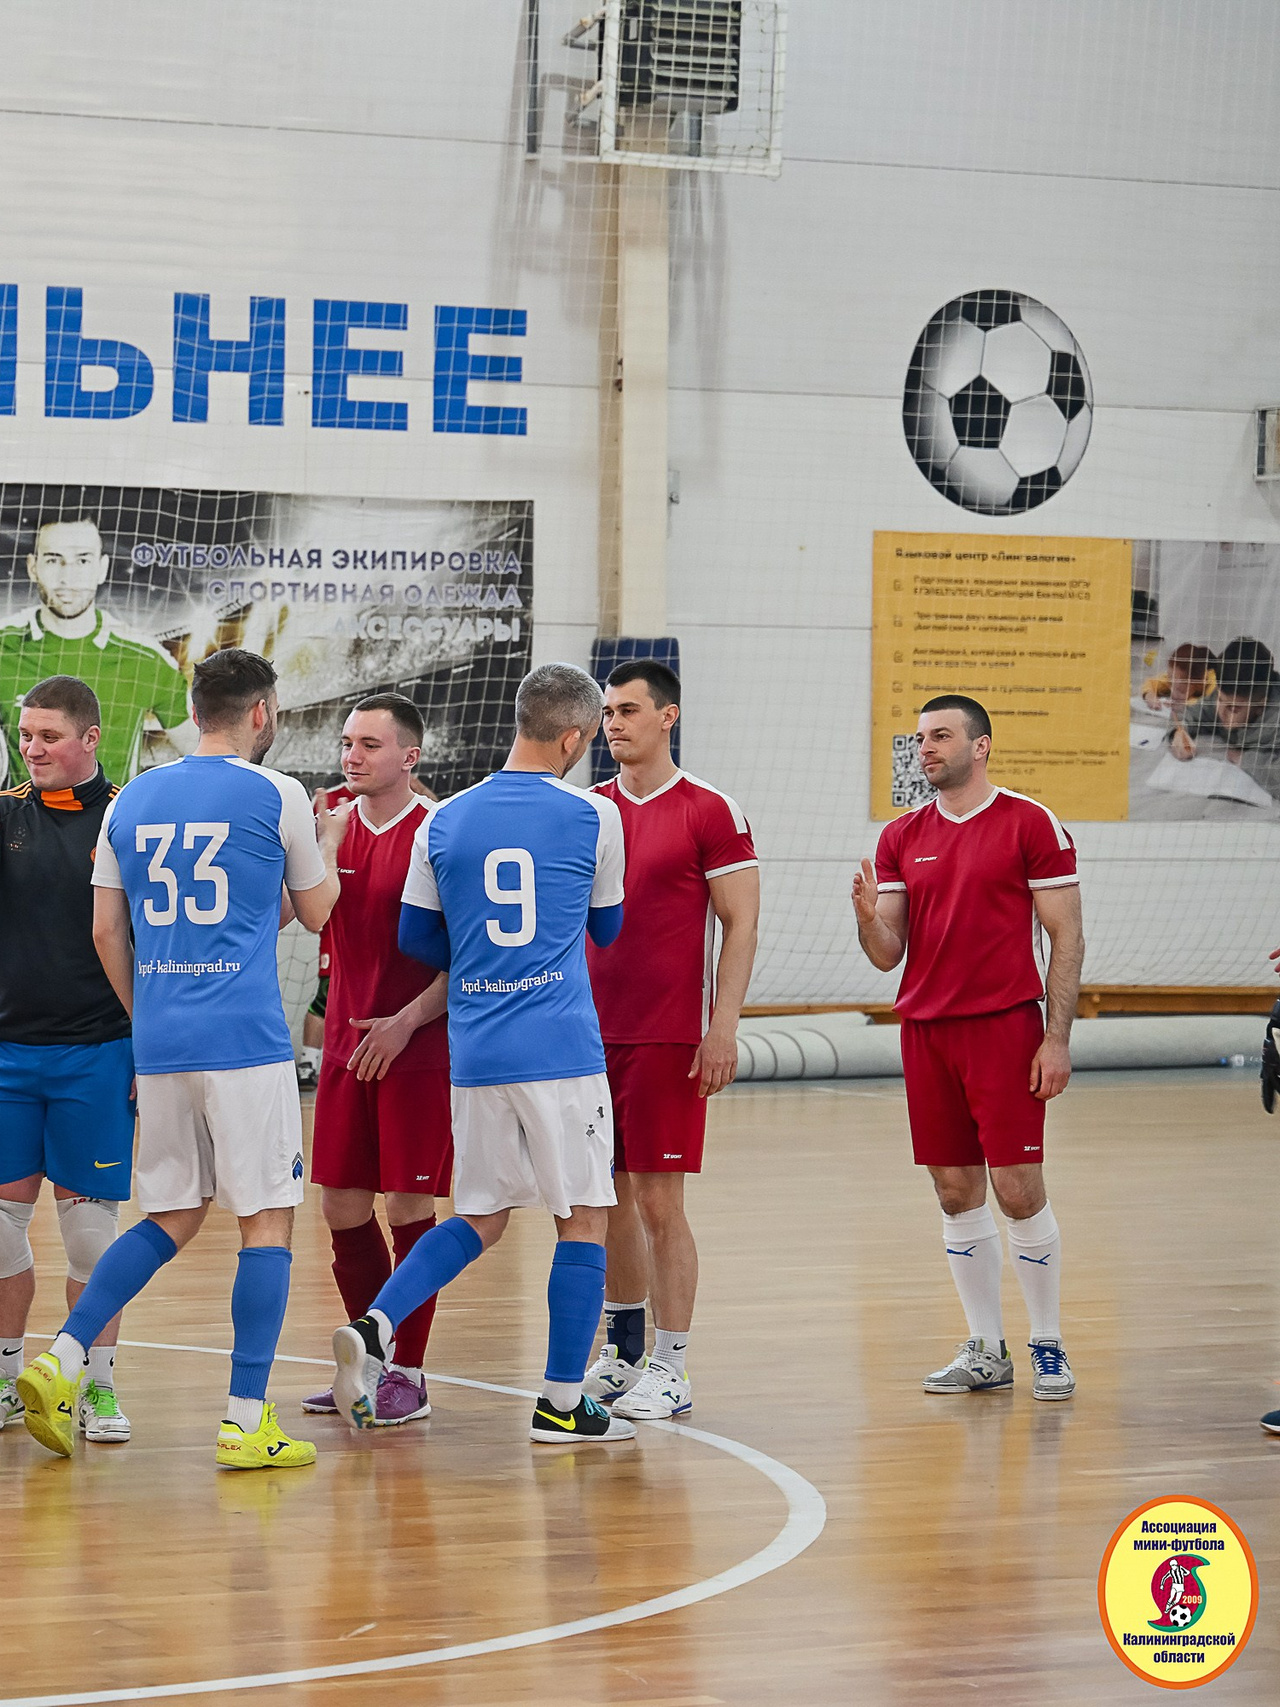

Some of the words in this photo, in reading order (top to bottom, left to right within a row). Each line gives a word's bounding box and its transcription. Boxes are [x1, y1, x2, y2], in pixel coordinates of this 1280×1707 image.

[131, 542, 322, 570] ФУТБОЛЬНАЯ
[331, 549, 523, 575] ЭКИПИРОВКА
[207, 581, 395, 605] СПОРТИВНАЯ
[402, 584, 523, 609] ОДЕЖДА
[331, 616, 521, 642] АКСЕССУАРЫ
[135, 822, 230, 926] 33
[483, 848, 537, 947] 9
